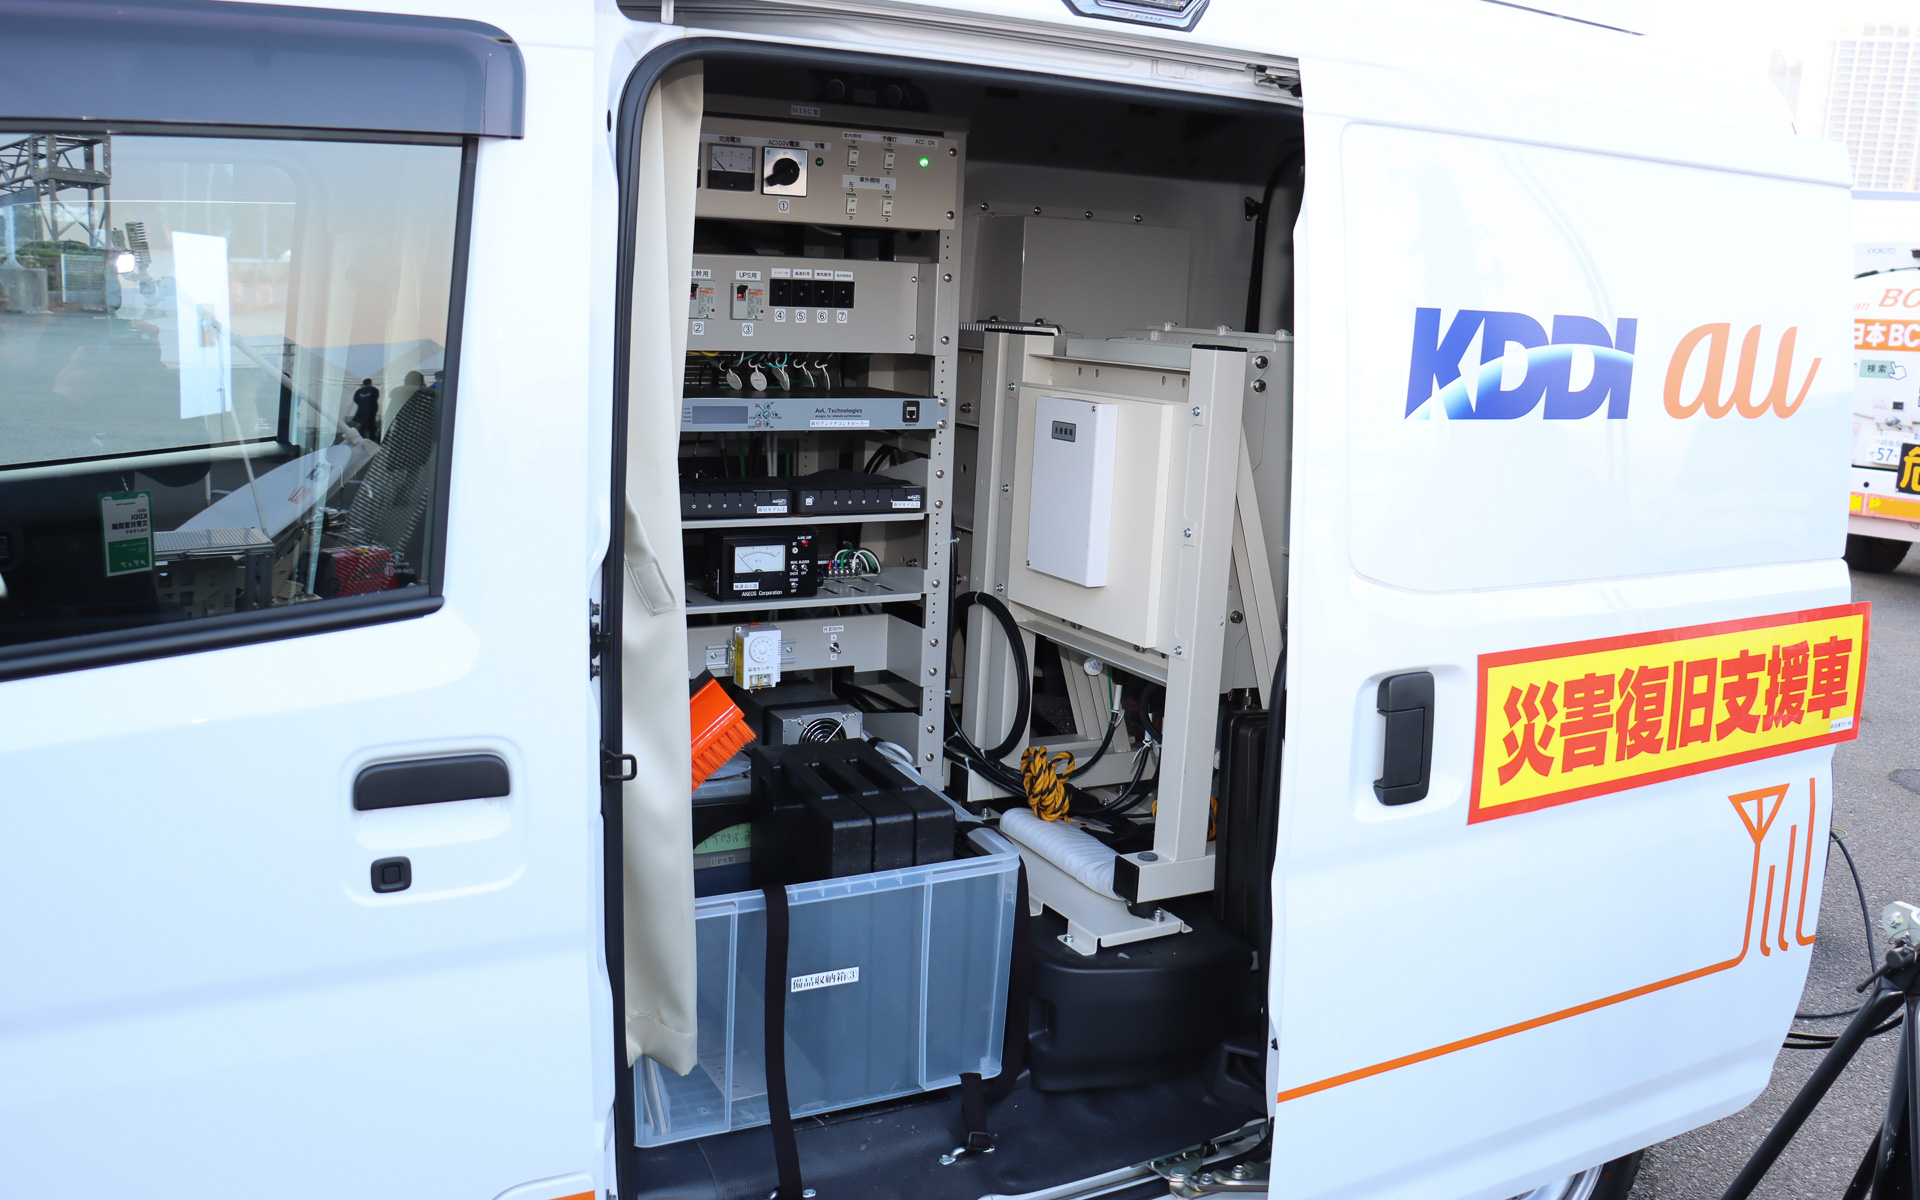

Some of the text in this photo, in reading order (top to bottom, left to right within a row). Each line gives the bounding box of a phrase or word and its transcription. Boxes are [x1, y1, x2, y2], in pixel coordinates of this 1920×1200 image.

[791, 106, 820, 116] MISC架
[882, 135, 897, 143] 予備灯
[1404, 307, 1638, 420] KDDI
[1663, 322, 1822, 420] au
[1867, 363, 1887, 373] 検索
[1497, 636, 1853, 786] 災害復旧支援車
[711, 856, 735, 866] UPS架
[792, 968, 858, 991] 備品収納箱③
